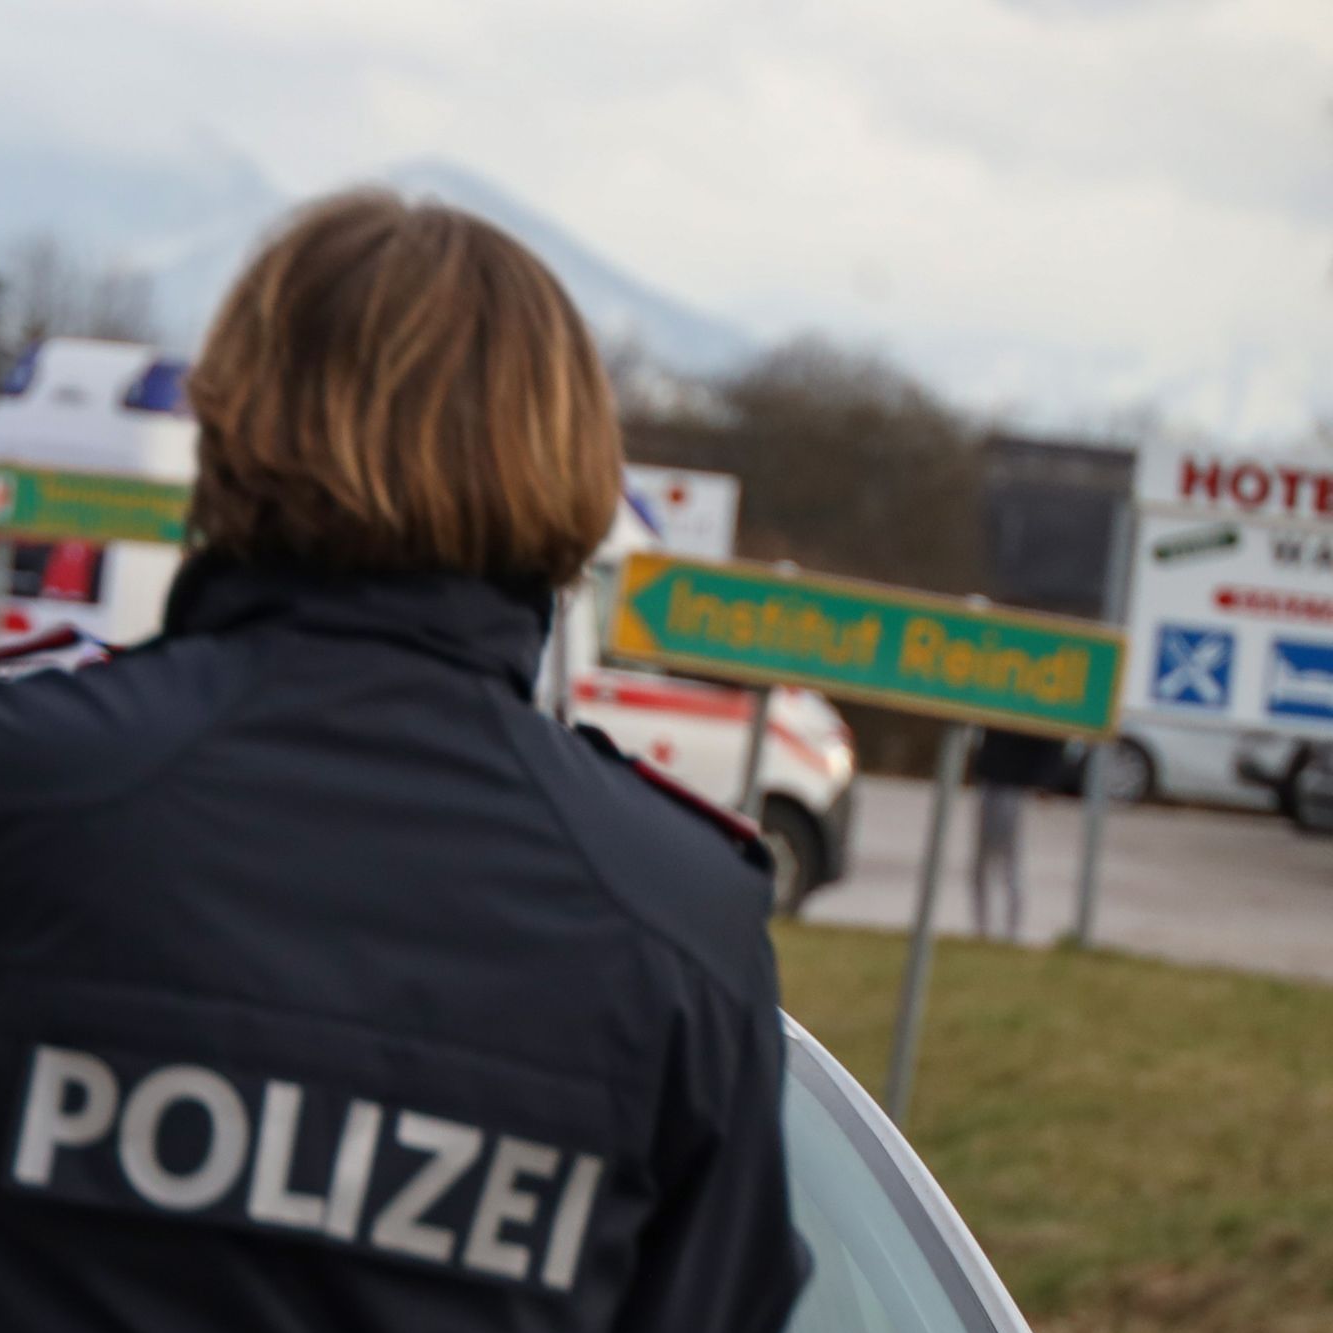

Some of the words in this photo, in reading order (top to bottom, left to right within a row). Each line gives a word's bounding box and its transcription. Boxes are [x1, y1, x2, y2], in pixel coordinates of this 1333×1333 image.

[665, 576, 883, 668] Institut
[897, 614, 1091, 704] Reindl
[12, 1044, 605, 1293] POLIZEI
